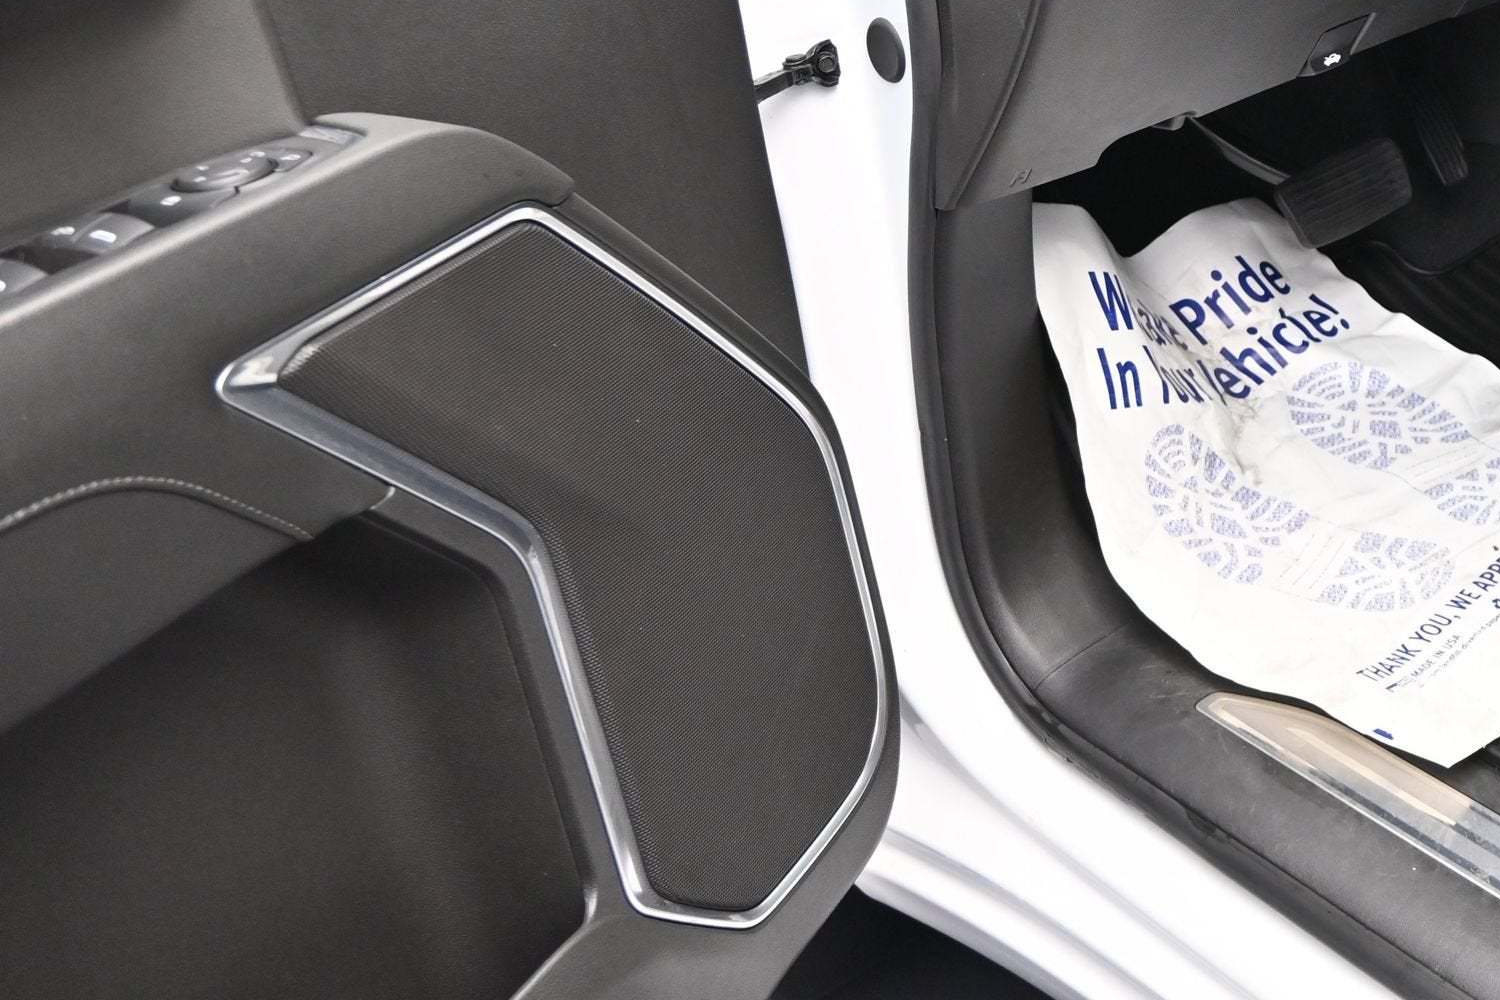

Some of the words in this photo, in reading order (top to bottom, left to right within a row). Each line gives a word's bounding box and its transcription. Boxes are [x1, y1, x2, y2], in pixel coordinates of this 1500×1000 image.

[1168, 254, 1291, 346] Pride
[1096, 347, 1144, 411] In
[1355, 643, 1422, 682] THANK
[1408, 613, 1462, 643] YOU,
[1445, 588, 1482, 611] WE
[1410, 659, 1435, 677] MADE
[1433, 650, 1445, 659] IN
[1442, 634, 1461, 650] USA
